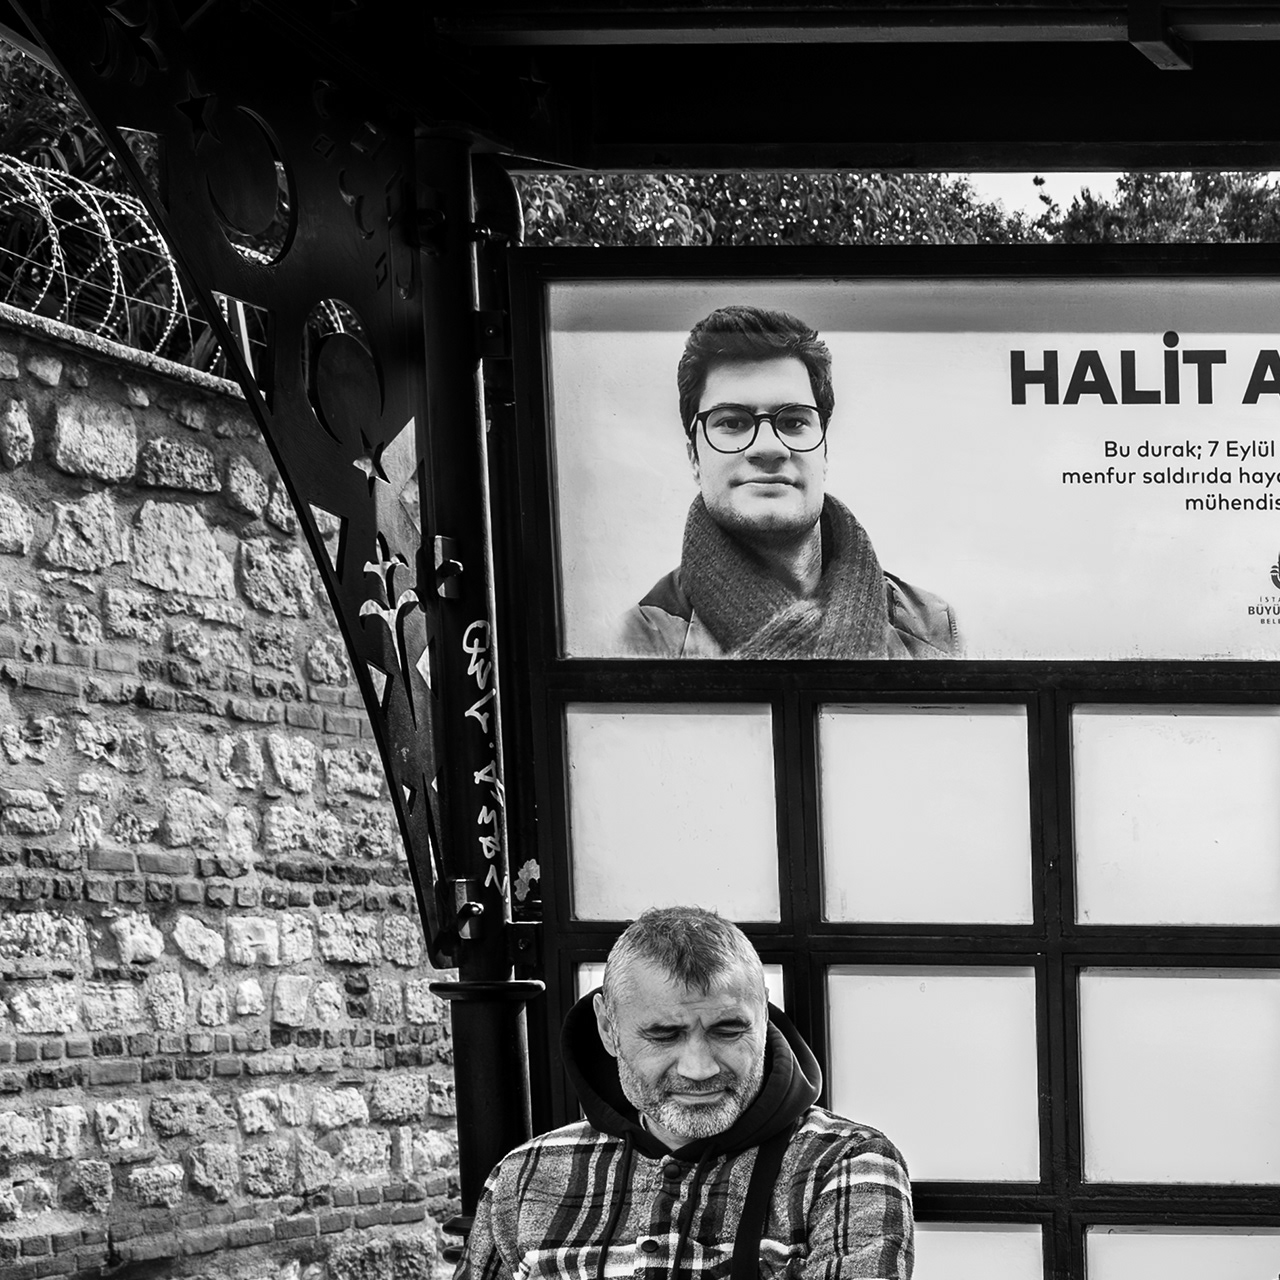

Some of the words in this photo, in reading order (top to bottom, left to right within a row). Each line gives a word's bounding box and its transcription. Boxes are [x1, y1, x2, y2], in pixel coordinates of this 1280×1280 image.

[1010, 330, 1227, 405] HALİT
[1104, 440, 1130, 458] Bu
[1137, 440, 1202, 460] durak;
[1207, 440, 1220, 457] 7
[1226, 440, 1275, 462] Eylül
[1062, 466, 1137, 484] menfur
[1142, 466, 1232, 484] saldırıda
